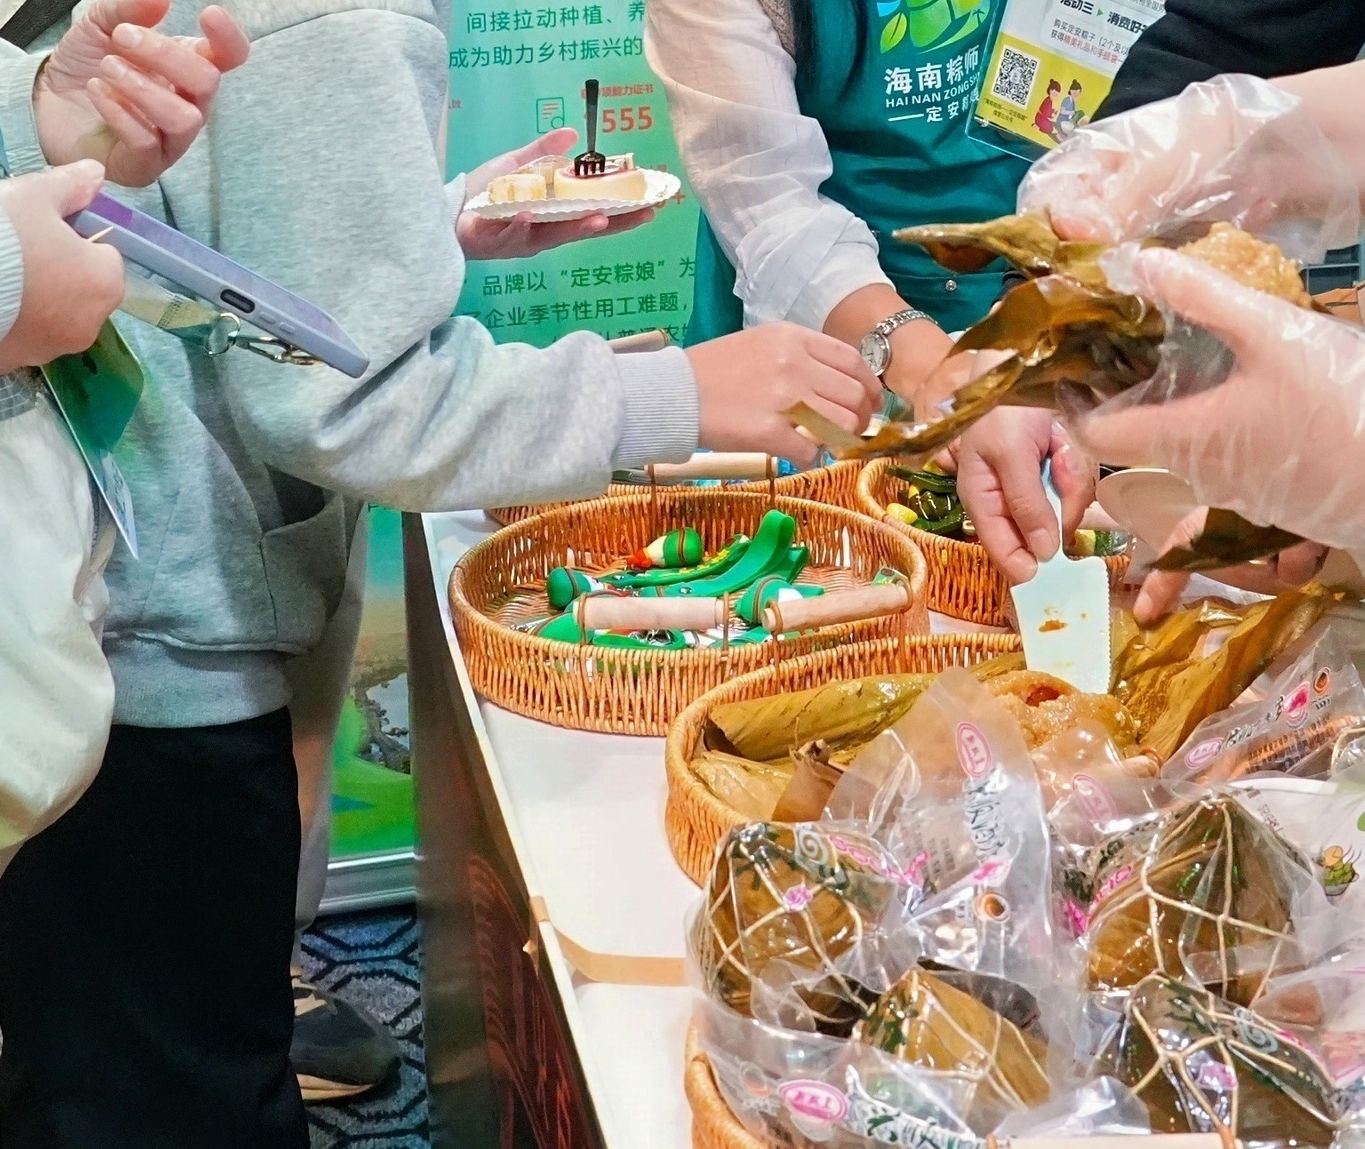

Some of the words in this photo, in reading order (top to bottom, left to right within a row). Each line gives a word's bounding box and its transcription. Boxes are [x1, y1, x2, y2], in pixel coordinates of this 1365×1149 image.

[467, 2, 645, 34] 间接拉动种植、养
[449, 36, 643, 69] 成为助力乡村振兴的
[884, 45, 979, 95] 海南粽师
[886, 96, 908, 108] HAI
[912, 92, 941, 105] NAN
[944, 81, 969, 100] ZONG
[585, 106, 653, 133] 555
